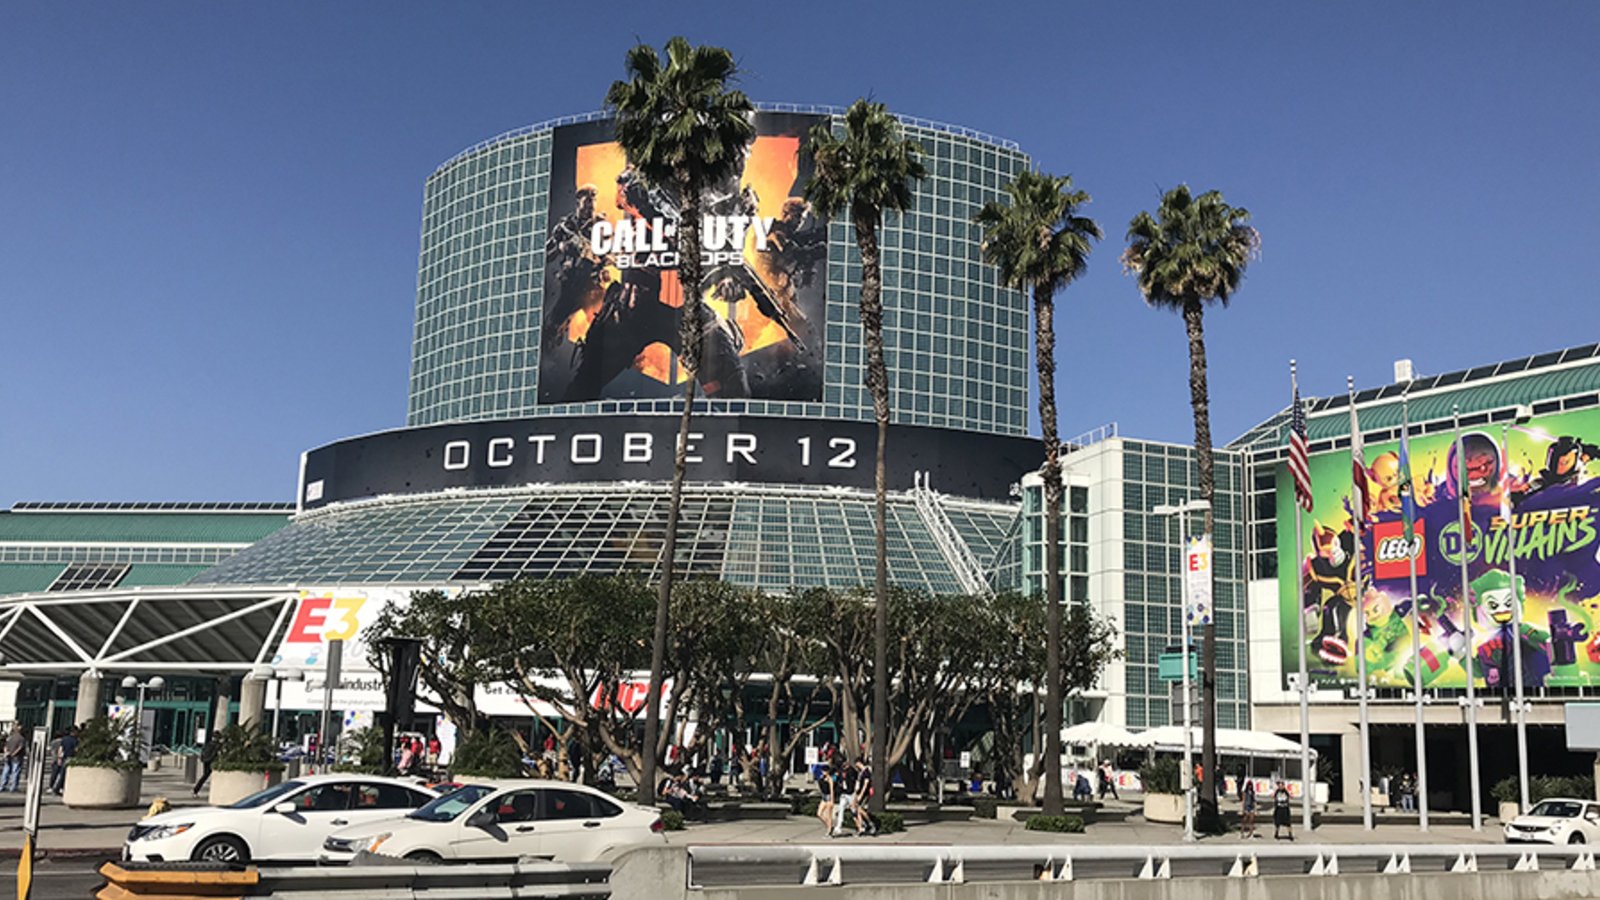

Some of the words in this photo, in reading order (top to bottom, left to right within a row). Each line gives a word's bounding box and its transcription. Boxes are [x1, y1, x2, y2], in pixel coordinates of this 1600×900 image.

[591, 217, 668, 256] CALL
[678, 214, 774, 251] UTY
[443, 432, 757, 470] OCTOBER
[797, 436, 857, 468] 12
[1378, 536, 1422, 560] LEGO
[1484, 516, 1597, 565] VILLAINS
[1189, 553, 1209, 571] E3
[286, 597, 367, 643] E3
